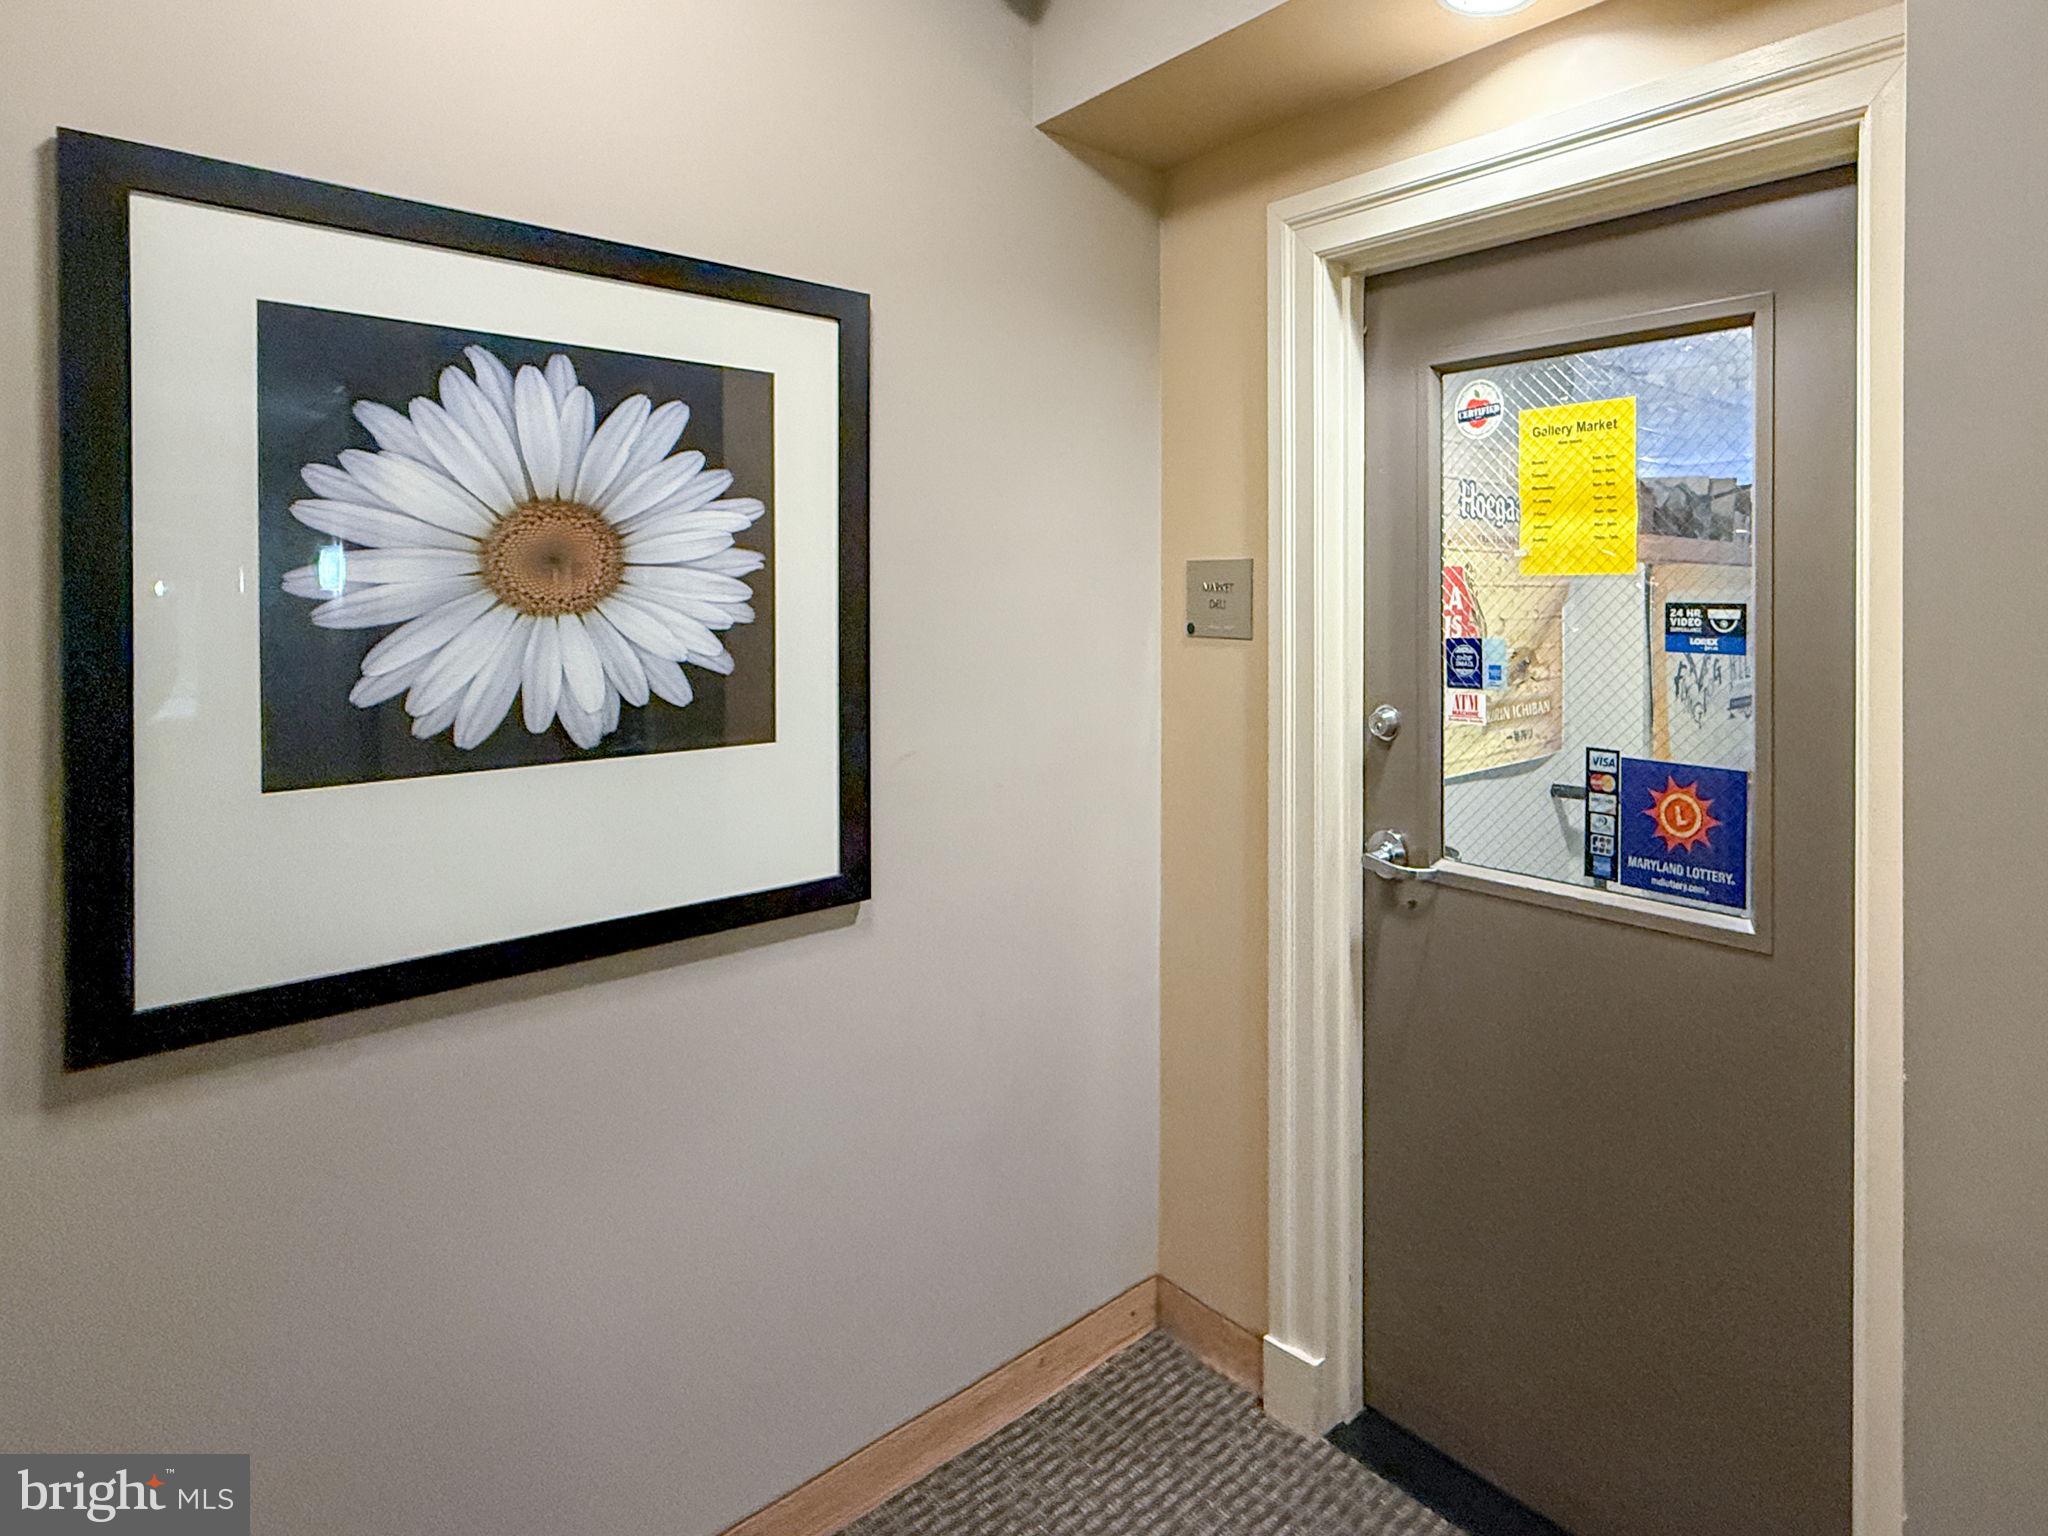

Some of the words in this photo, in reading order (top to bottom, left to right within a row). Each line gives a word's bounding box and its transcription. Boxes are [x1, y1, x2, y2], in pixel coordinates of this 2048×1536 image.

[1532, 425, 1572, 437] Gallery
[1576, 418, 1617, 432] Market
[1669, 608, 1684, 618] 24
[1669, 617, 1703, 627] VIDEO
[1592, 756, 1616, 768] VISA
[1627, 855, 1684, 877] MARYLAND
